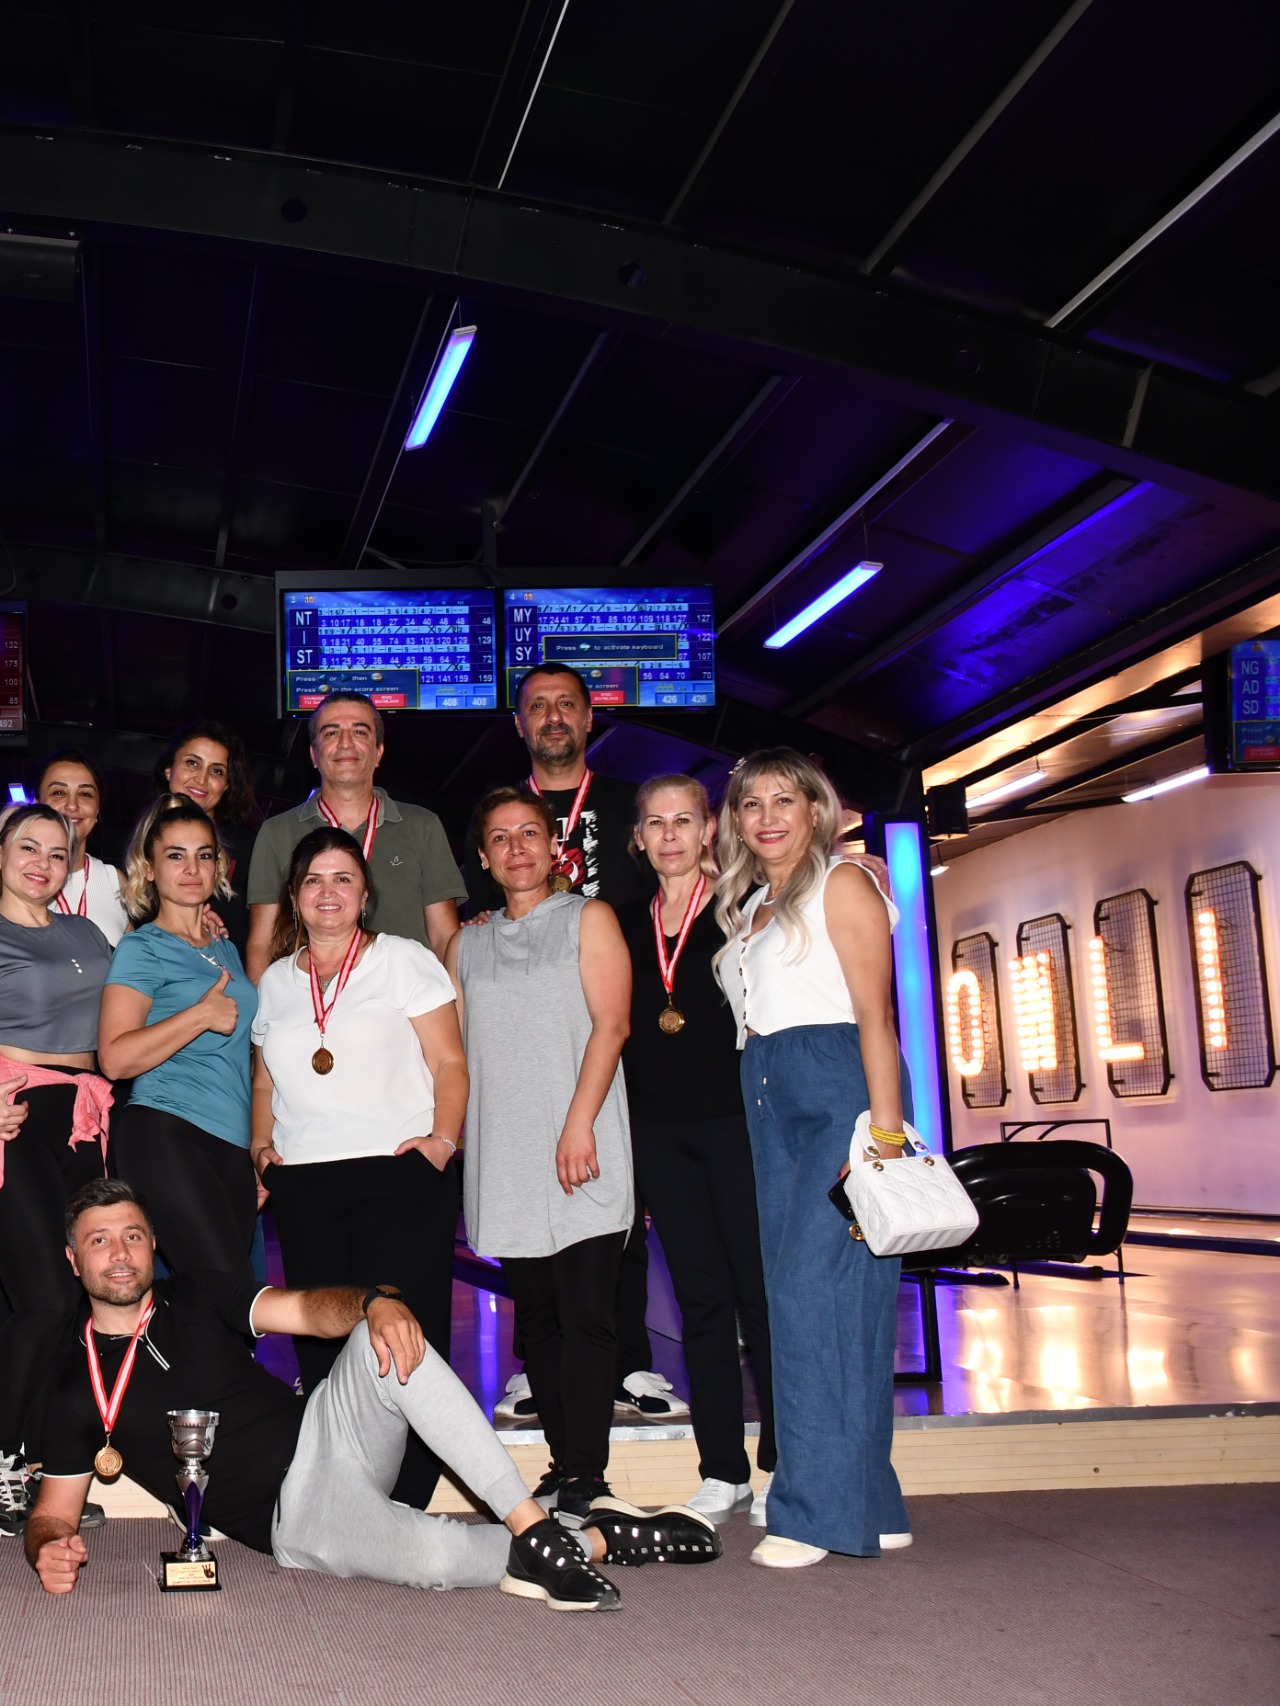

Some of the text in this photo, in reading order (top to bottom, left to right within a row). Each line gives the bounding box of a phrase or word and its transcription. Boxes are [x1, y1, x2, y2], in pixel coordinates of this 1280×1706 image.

[290, 596, 296, 604] 3
[510, 592, 515, 600] 4
[296, 611, 312, 626] NT
[514, 608, 532, 622] MY
[515, 627, 532, 642] UY
[297, 649, 313, 664] ST
[515, 646, 532, 661] SY
[1241, 660, 1259, 675] NG
[1242, 680, 1259, 695] AD
[442, 698, 487, 706] 408 408
[691, 695, 707, 703] 426
[1242, 700, 1259, 714] SD
